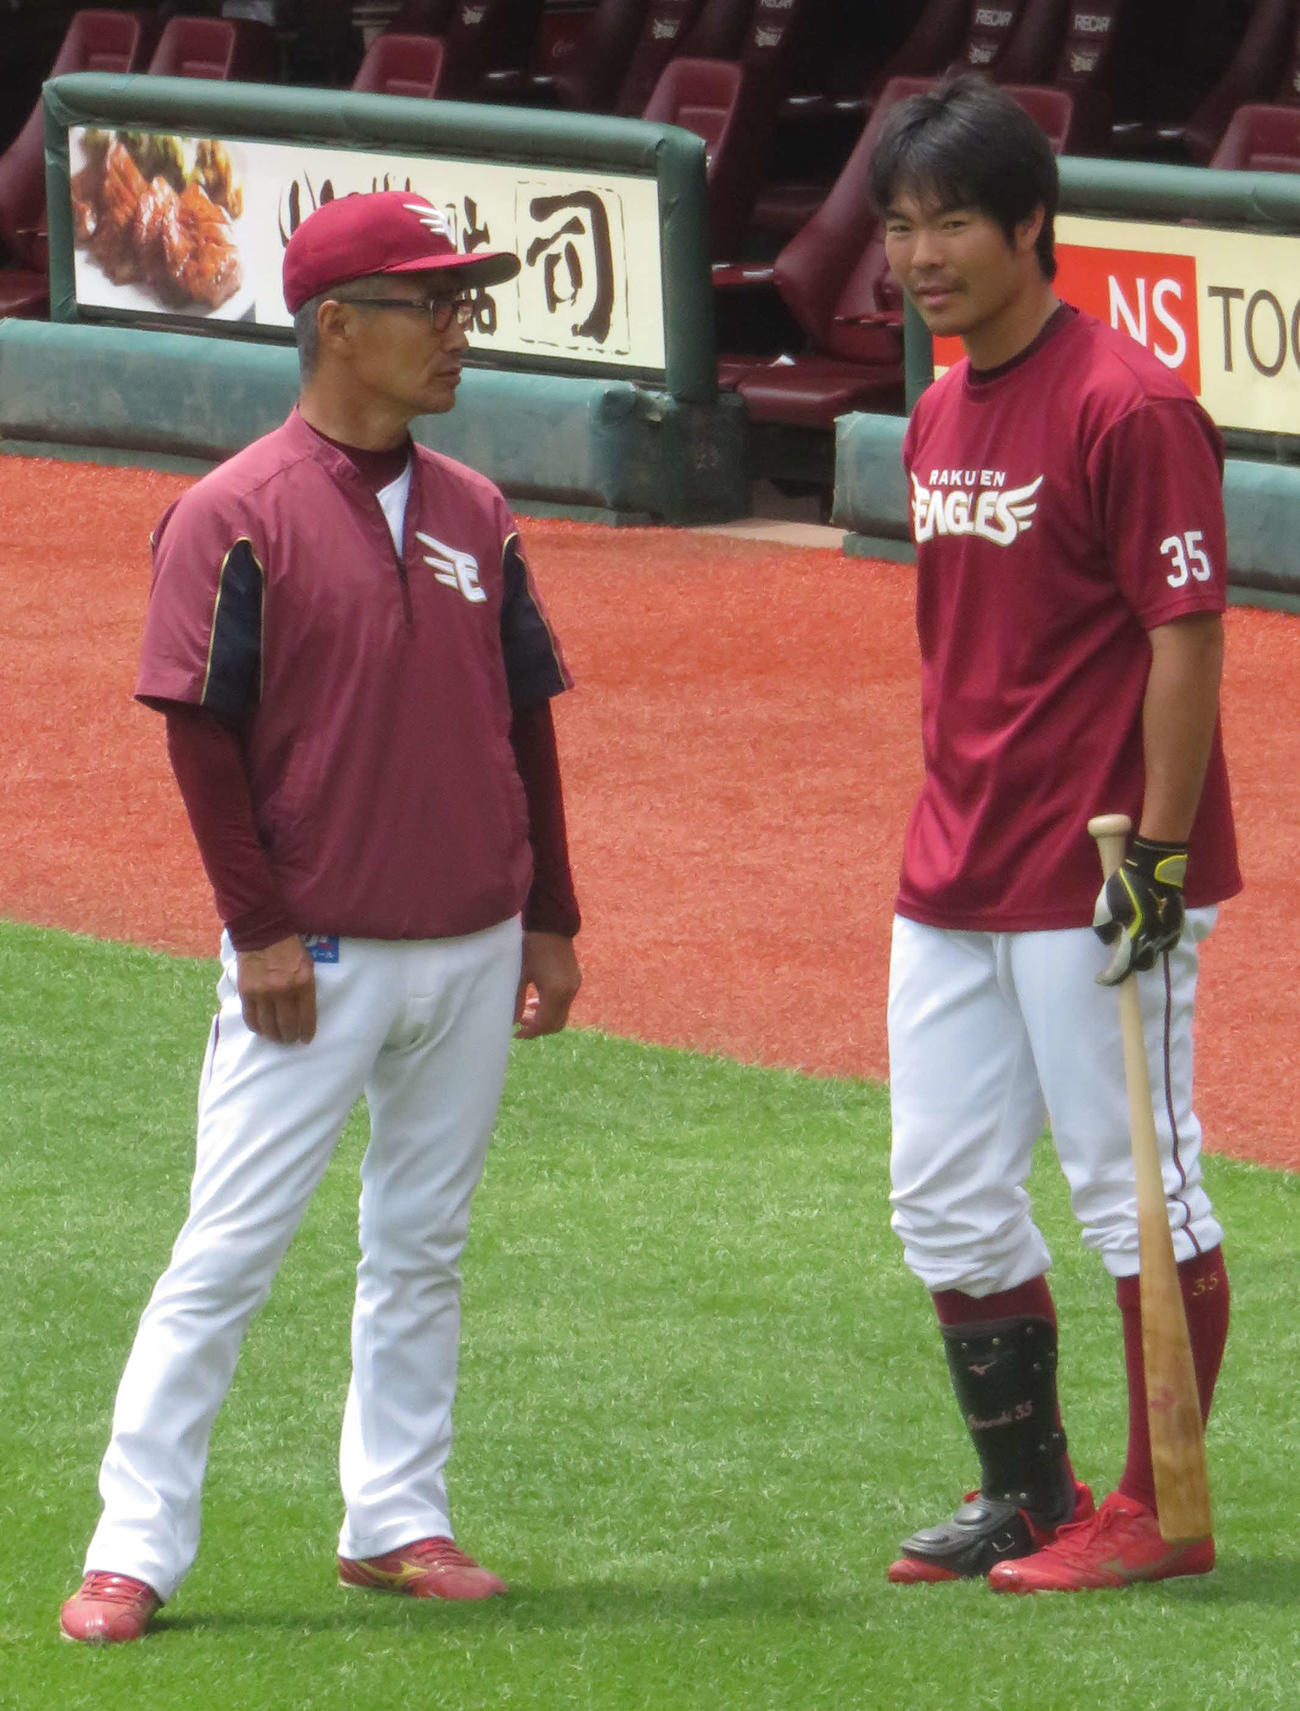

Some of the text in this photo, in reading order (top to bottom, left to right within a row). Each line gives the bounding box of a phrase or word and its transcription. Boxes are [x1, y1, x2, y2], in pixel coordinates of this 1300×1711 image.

[1207, 285, 1300, 378] TO
[911, 471, 1044, 547] EAGLES
[929, 469, 1006, 487] RAKUEN
[1160, 530, 1211, 588] 35
